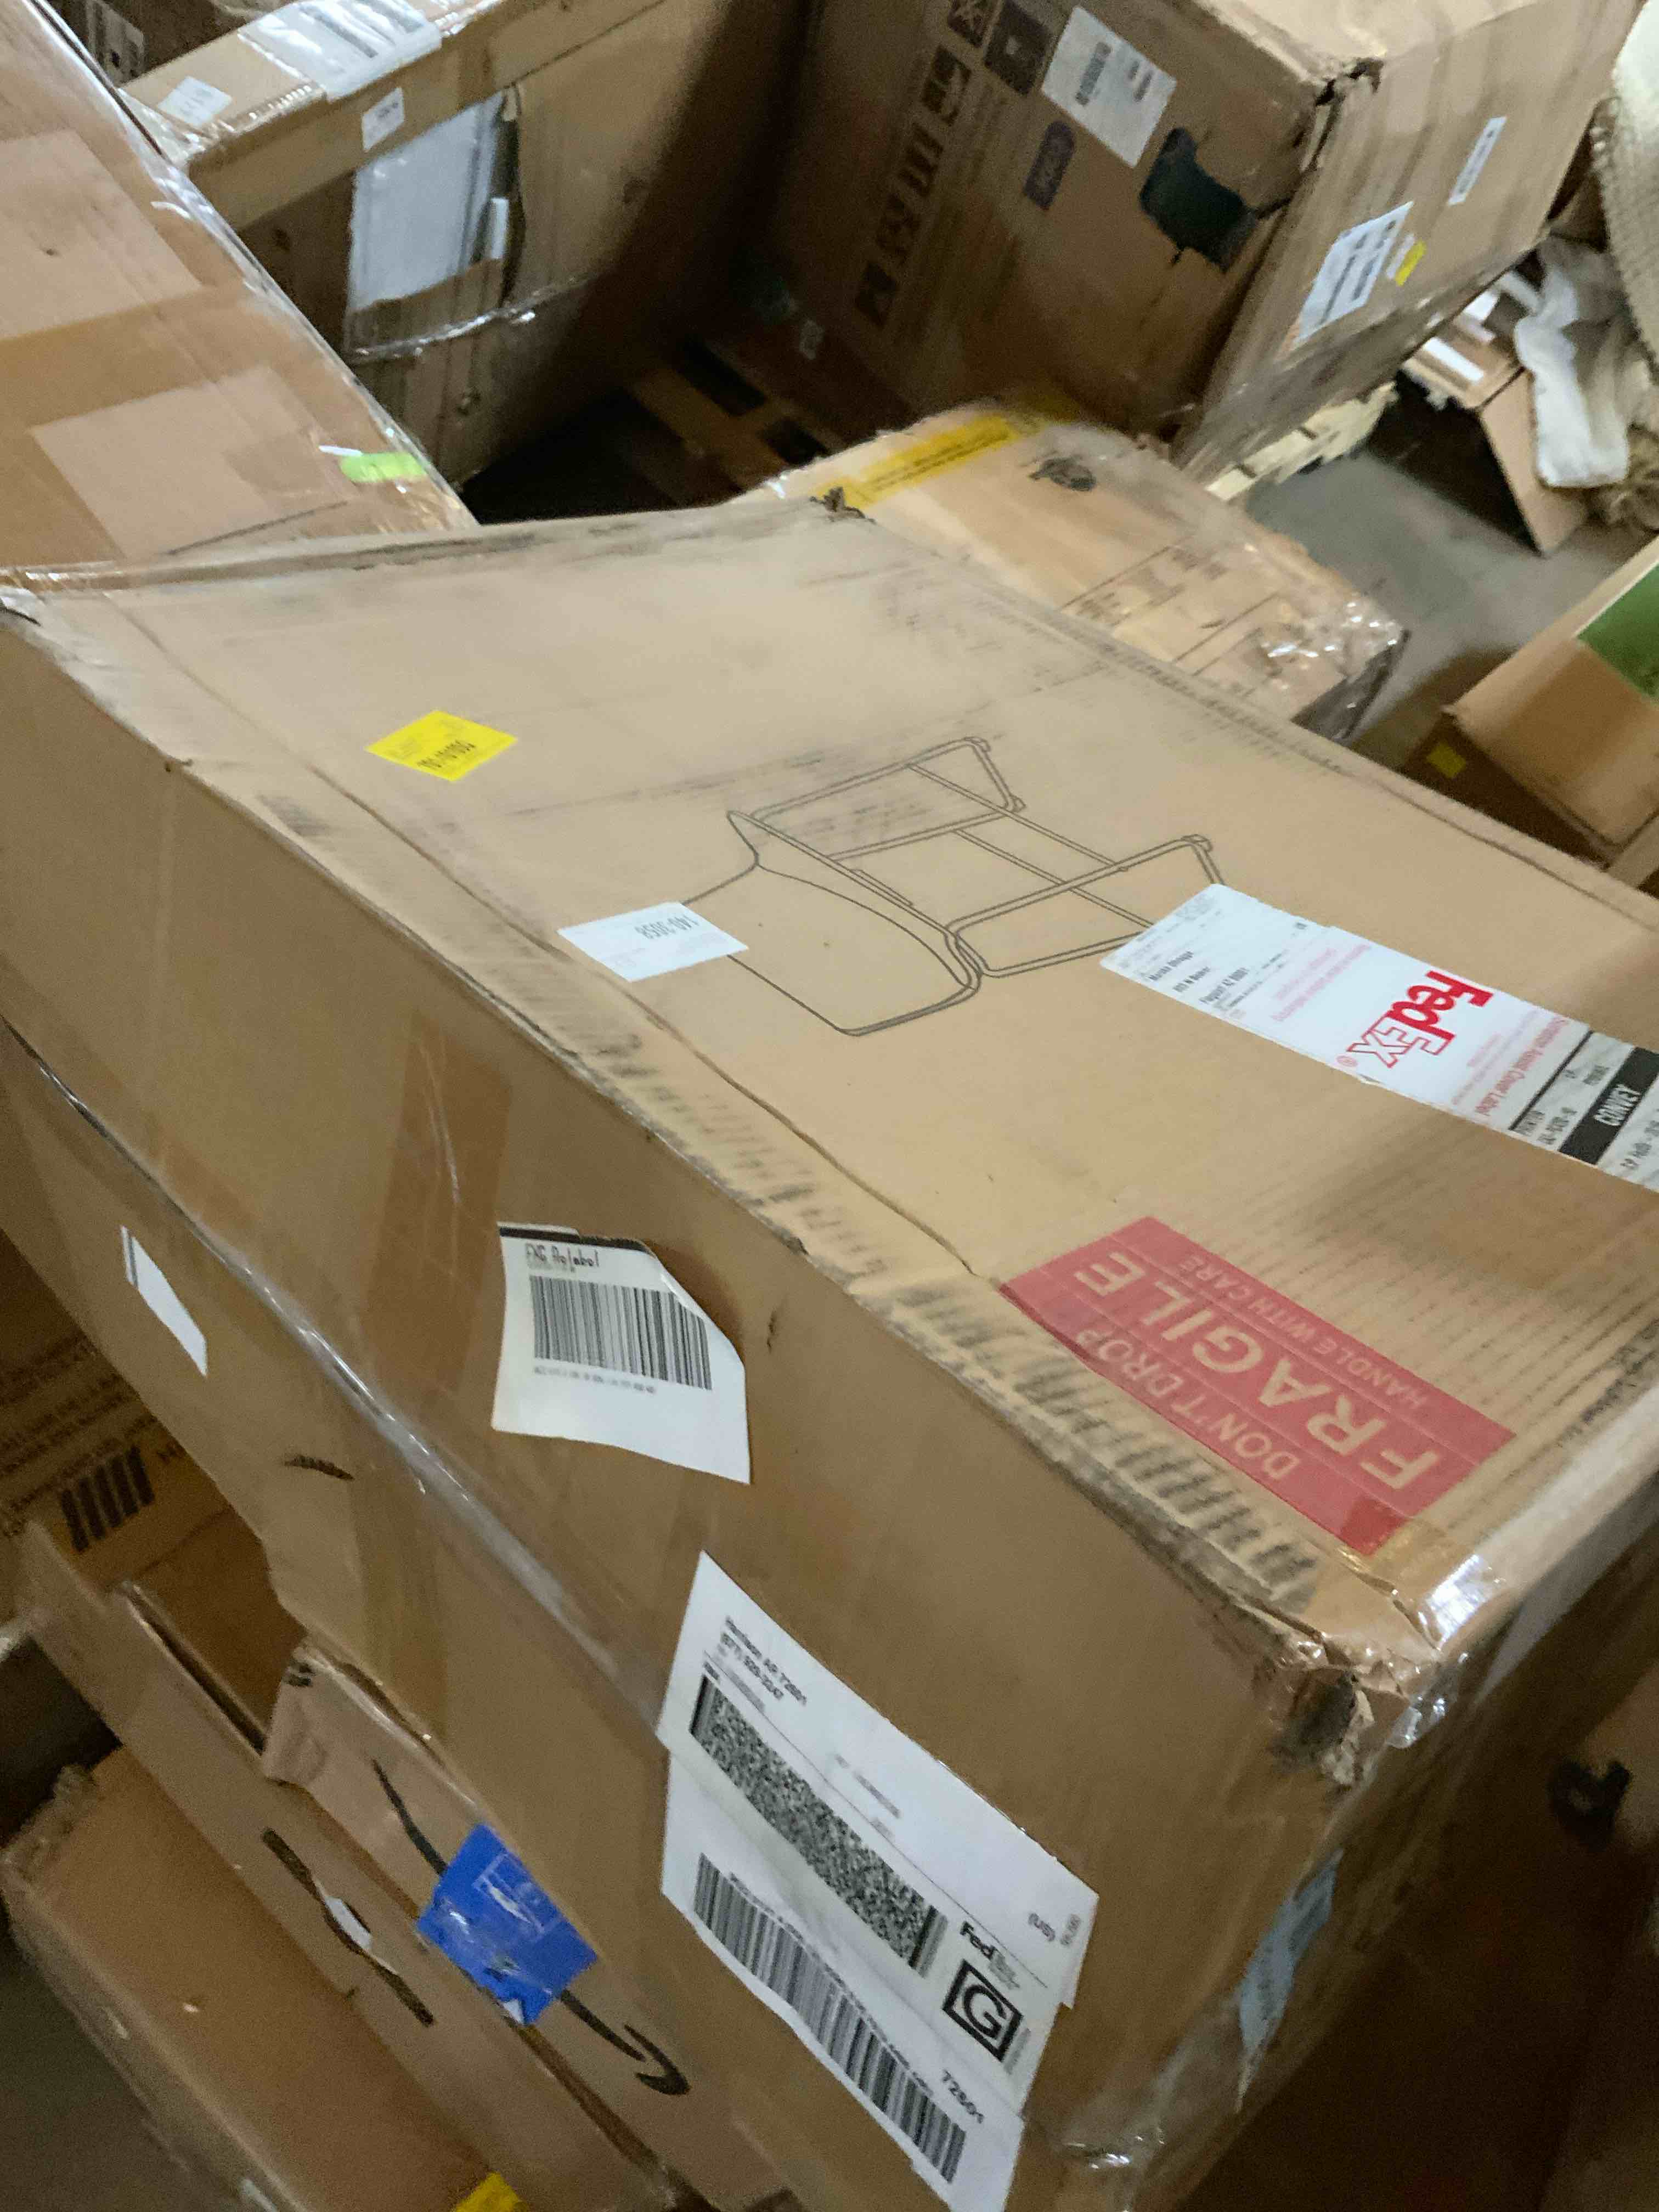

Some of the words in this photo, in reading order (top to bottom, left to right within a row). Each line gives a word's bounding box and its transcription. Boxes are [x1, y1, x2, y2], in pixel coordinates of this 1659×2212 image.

[1346, 970, 1494, 1069] FedEx
[1177, 1252, 1253, 1301] CARE
[1246, 1295, 1317, 1346] WITH
[1074, 1250, 1439, 1491] FRAGILE
[1076, 1328, 1183, 1400] DROP
[1316, 1334, 1427, 1410] HANDLE
[1172, 1394, 1302, 1481] DON'T
[963, 1984, 1007, 2040] G
